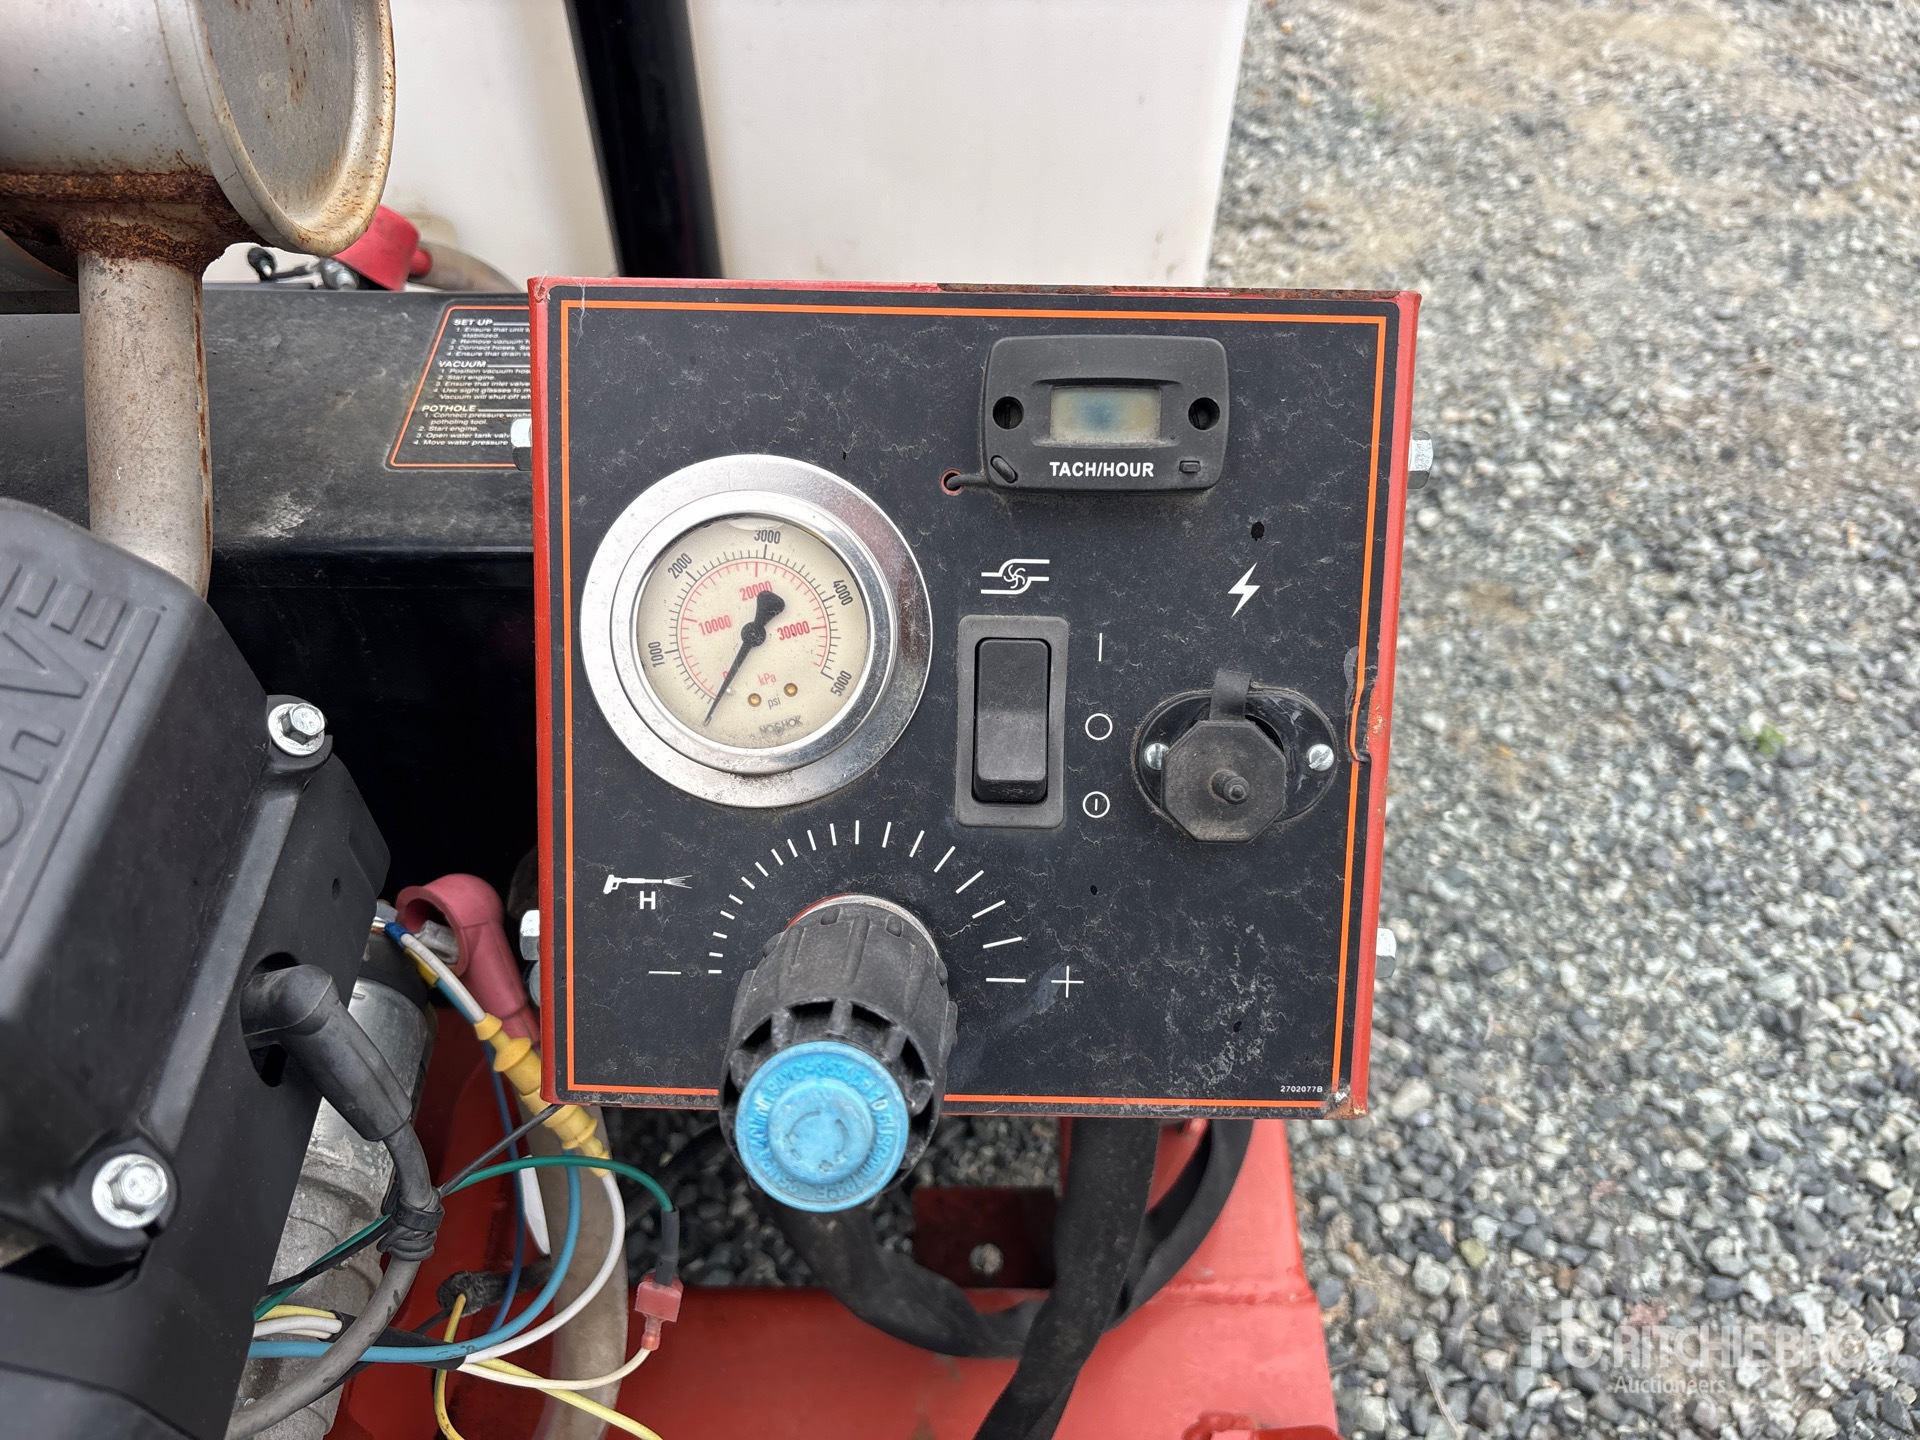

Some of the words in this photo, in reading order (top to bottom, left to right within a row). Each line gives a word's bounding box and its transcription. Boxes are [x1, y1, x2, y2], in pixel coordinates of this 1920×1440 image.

[454, 318, 475, 326] SET
[476, 318, 494, 326] UP
[438, 360, 487, 368] VACUUM
[422, 404, 477, 412] POTHOLE
[1049, 461, 1154, 477] TACH/HOUR
[753, 529, 781, 545] 3000
[667, 553, 693, 579] 2000
[832, 579, 854, 606] 4000
[699, 615, 732, 636] 10000
[777, 620, 811, 641] 30000
[648, 641, 666, 668] 1000
[758, 673, 777, 687] kPa
[830, 670, 853, 697] 5000
[767, 696, 782, 710] psi
[758, 715, 804, 736] NOSHOK
[639, 890, 656, 910] H
[1280, 1085, 1323, 1093] 2702077B
